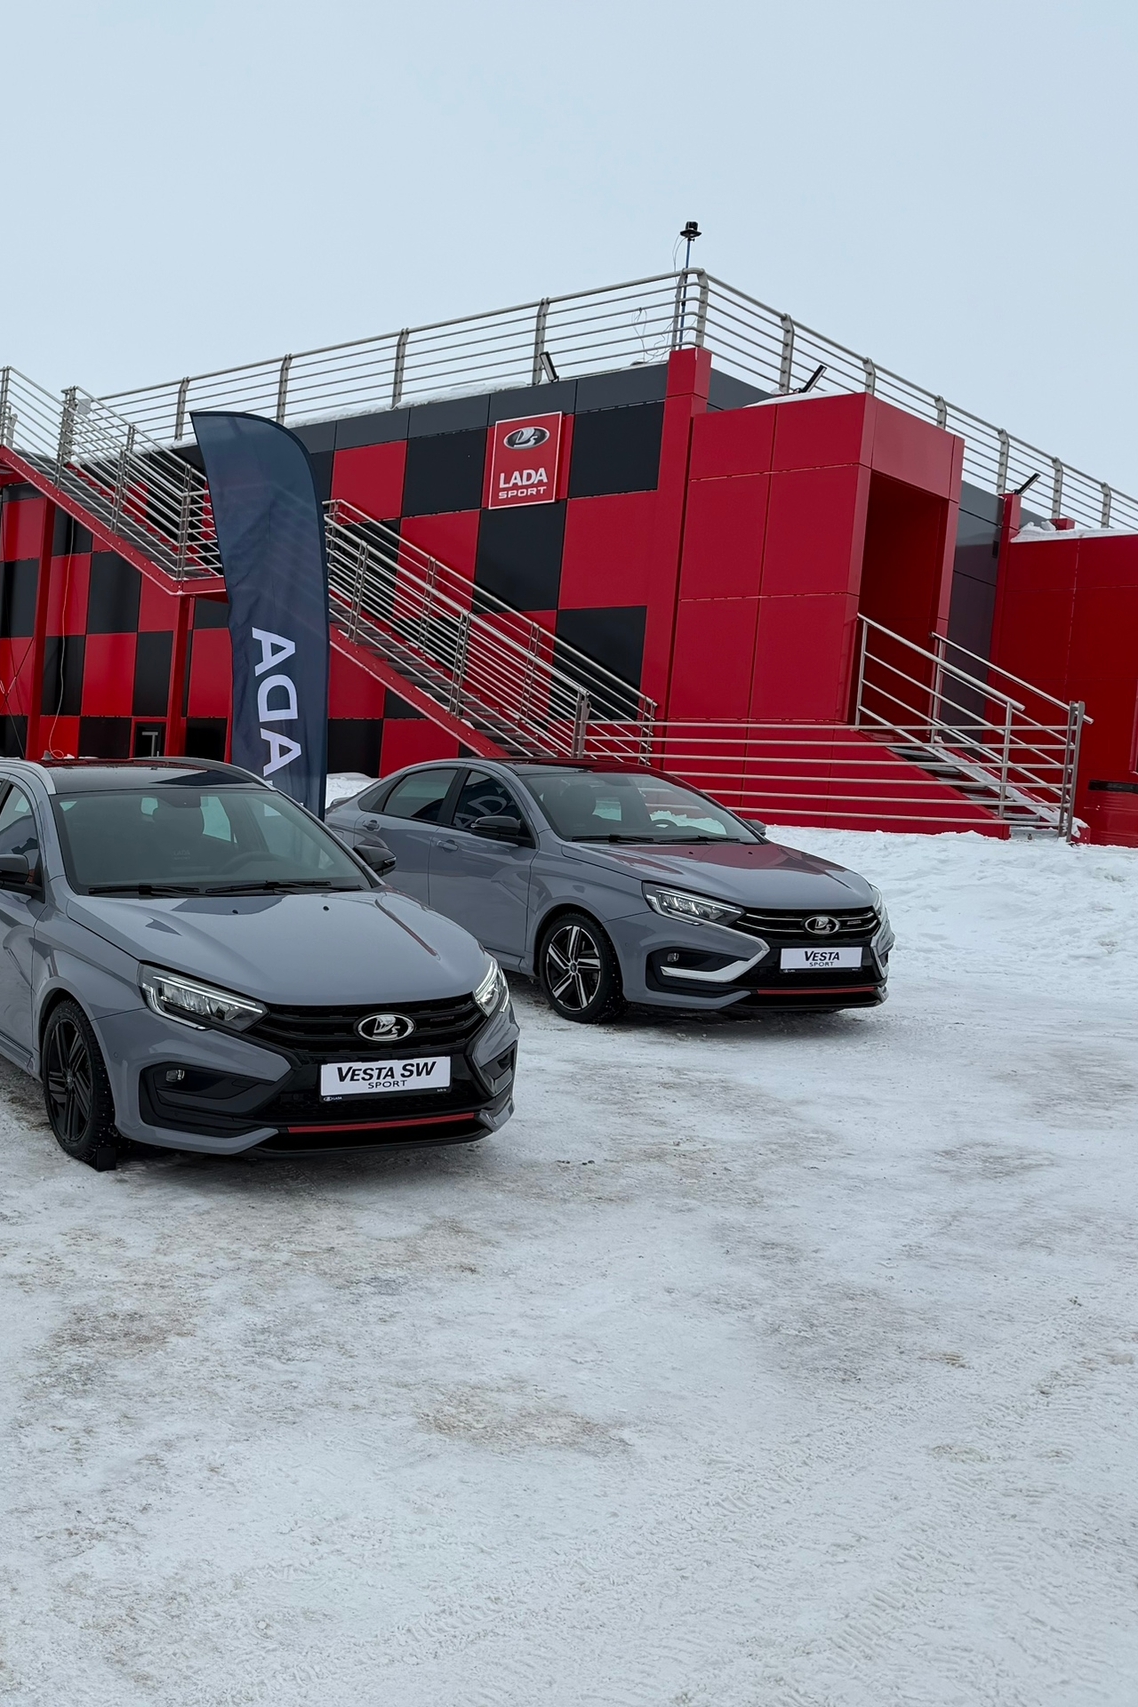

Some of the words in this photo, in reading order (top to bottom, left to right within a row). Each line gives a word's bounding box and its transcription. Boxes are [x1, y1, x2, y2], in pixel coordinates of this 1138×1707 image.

[499, 467, 548, 489] LADA
[498, 486, 547, 500] SPORT
[804, 950, 840, 962] VESTA
[336, 1066, 395, 1083] VESTA
[400, 1061, 437, 1079] SW
[368, 1080, 408, 1089] SPORT
